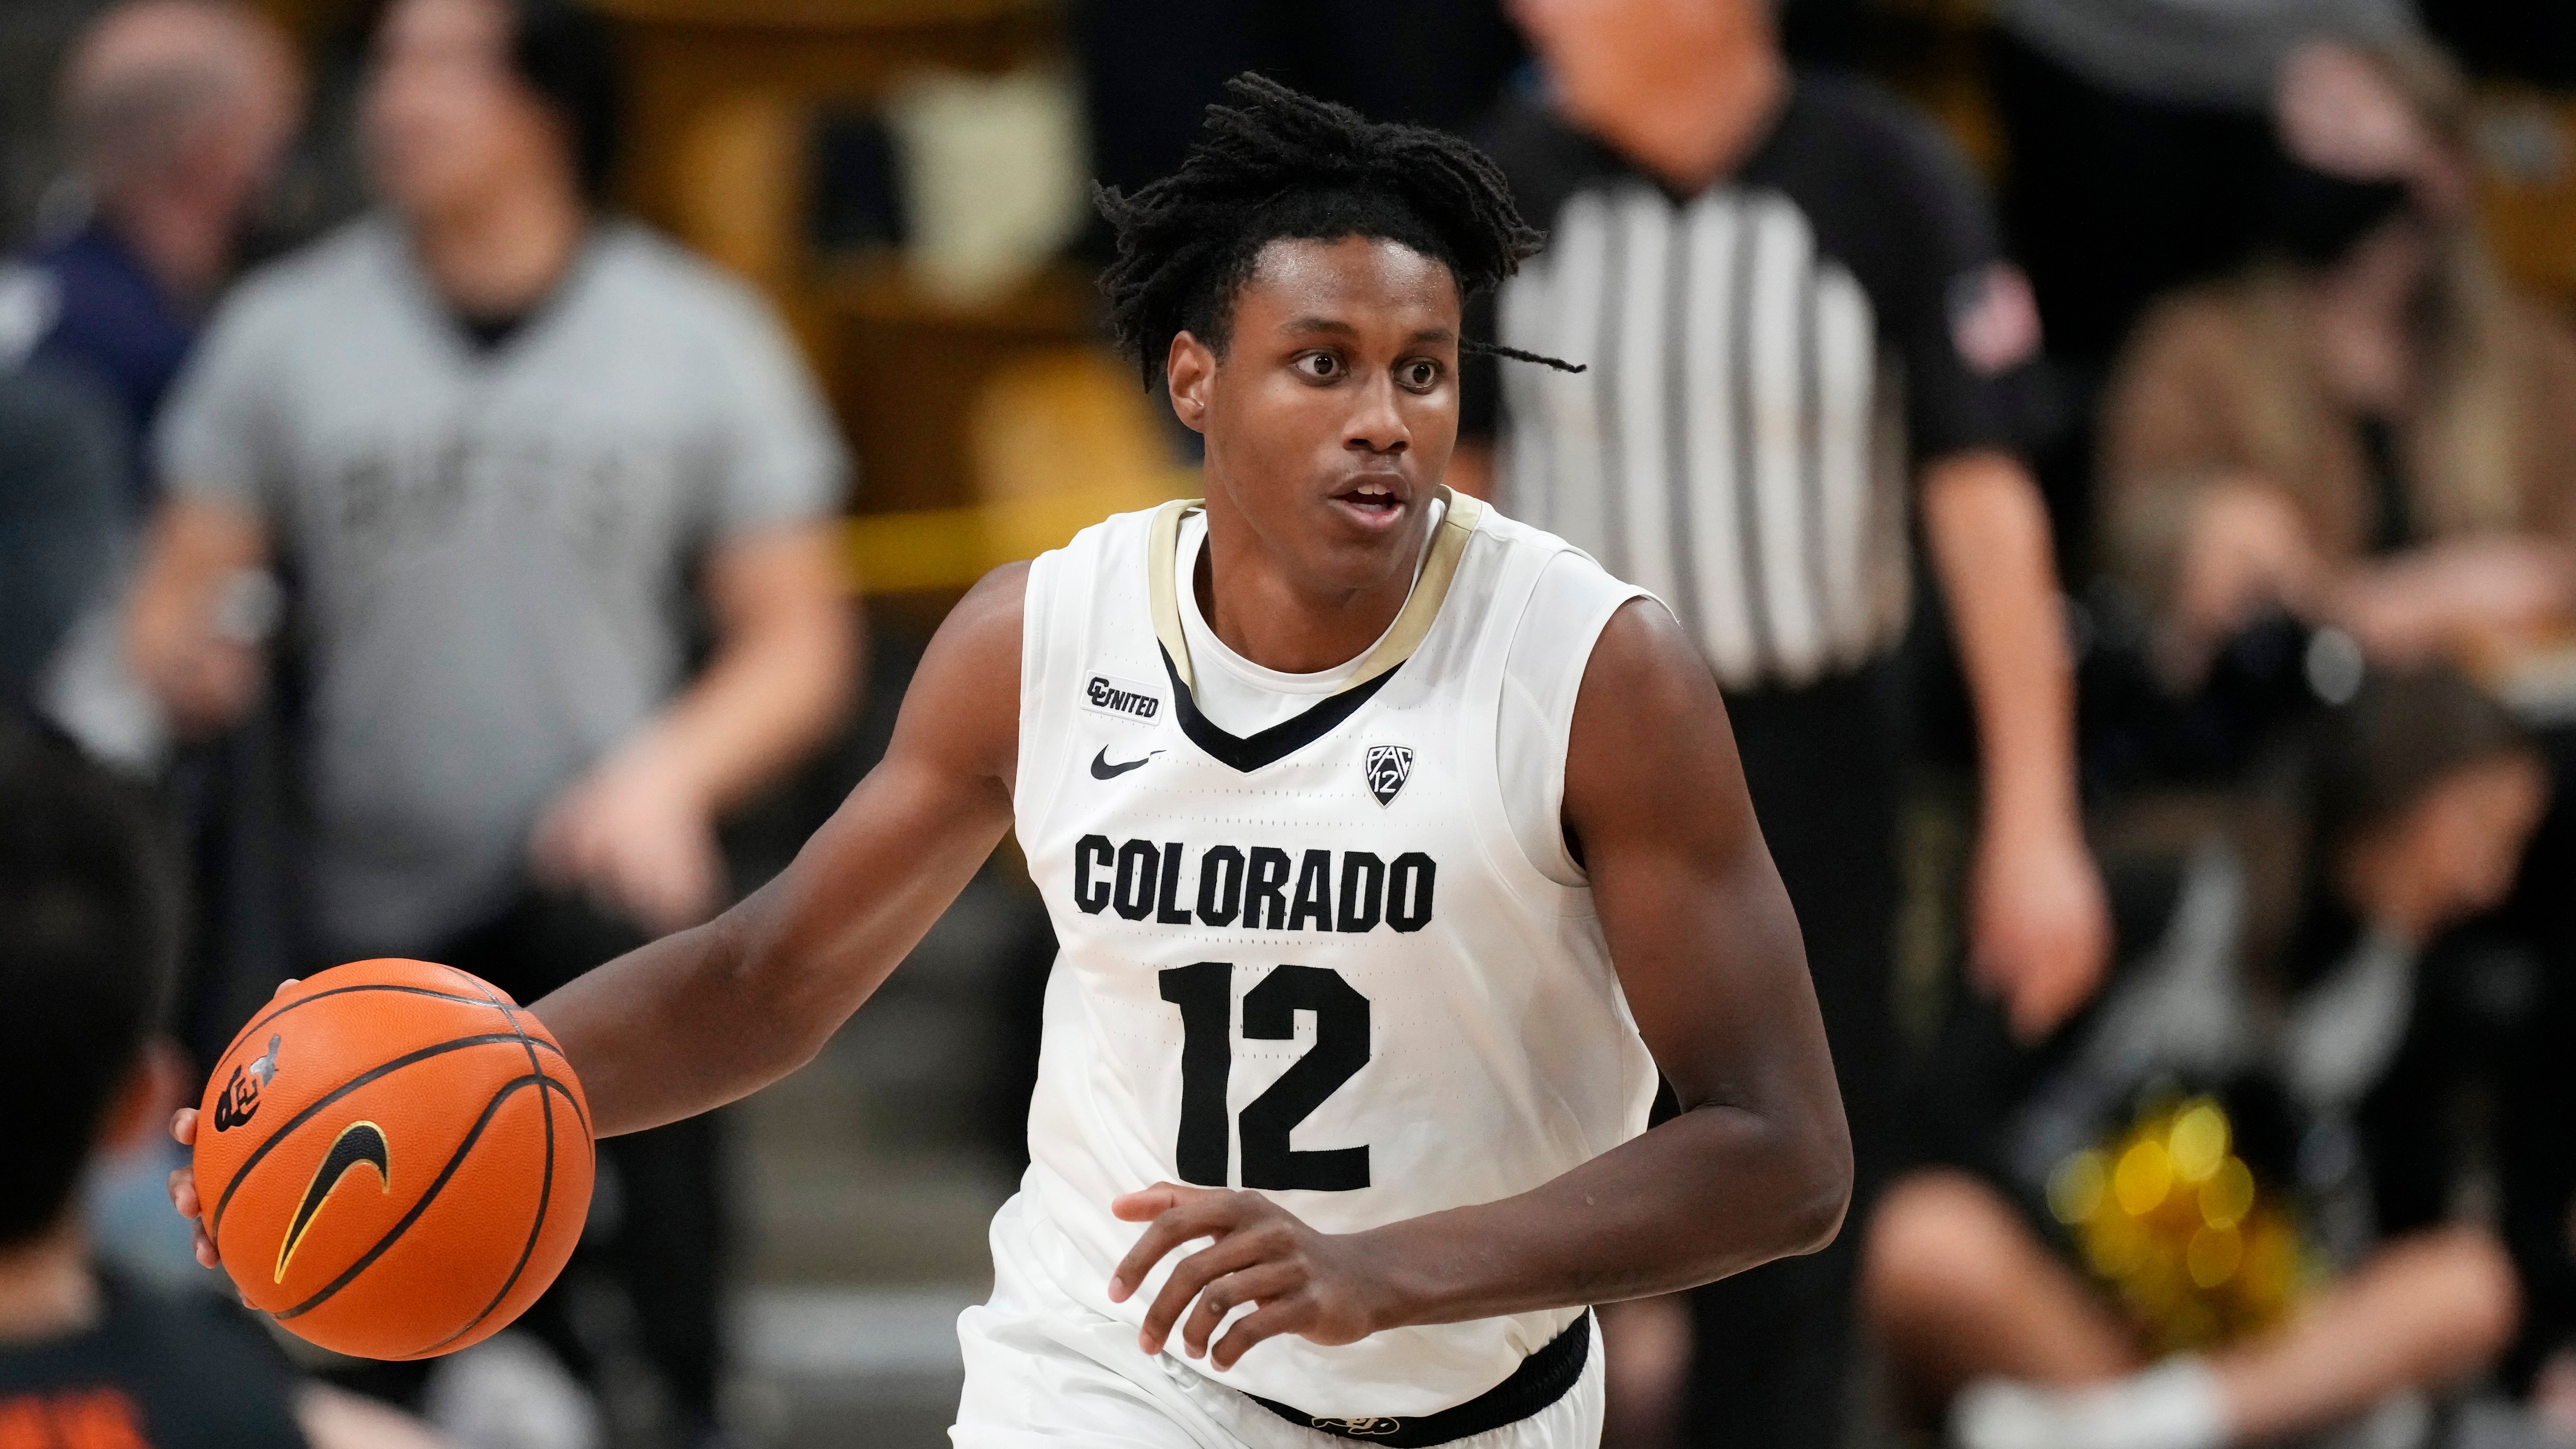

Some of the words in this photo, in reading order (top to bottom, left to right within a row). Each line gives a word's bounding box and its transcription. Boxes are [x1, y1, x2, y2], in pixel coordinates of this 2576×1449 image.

[1367, 746, 1413, 781] PAC
[1374, 770, 1398, 793] 12
[1075, 834, 1436, 934] COLORADO
[1158, 961, 1371, 1192] 12
